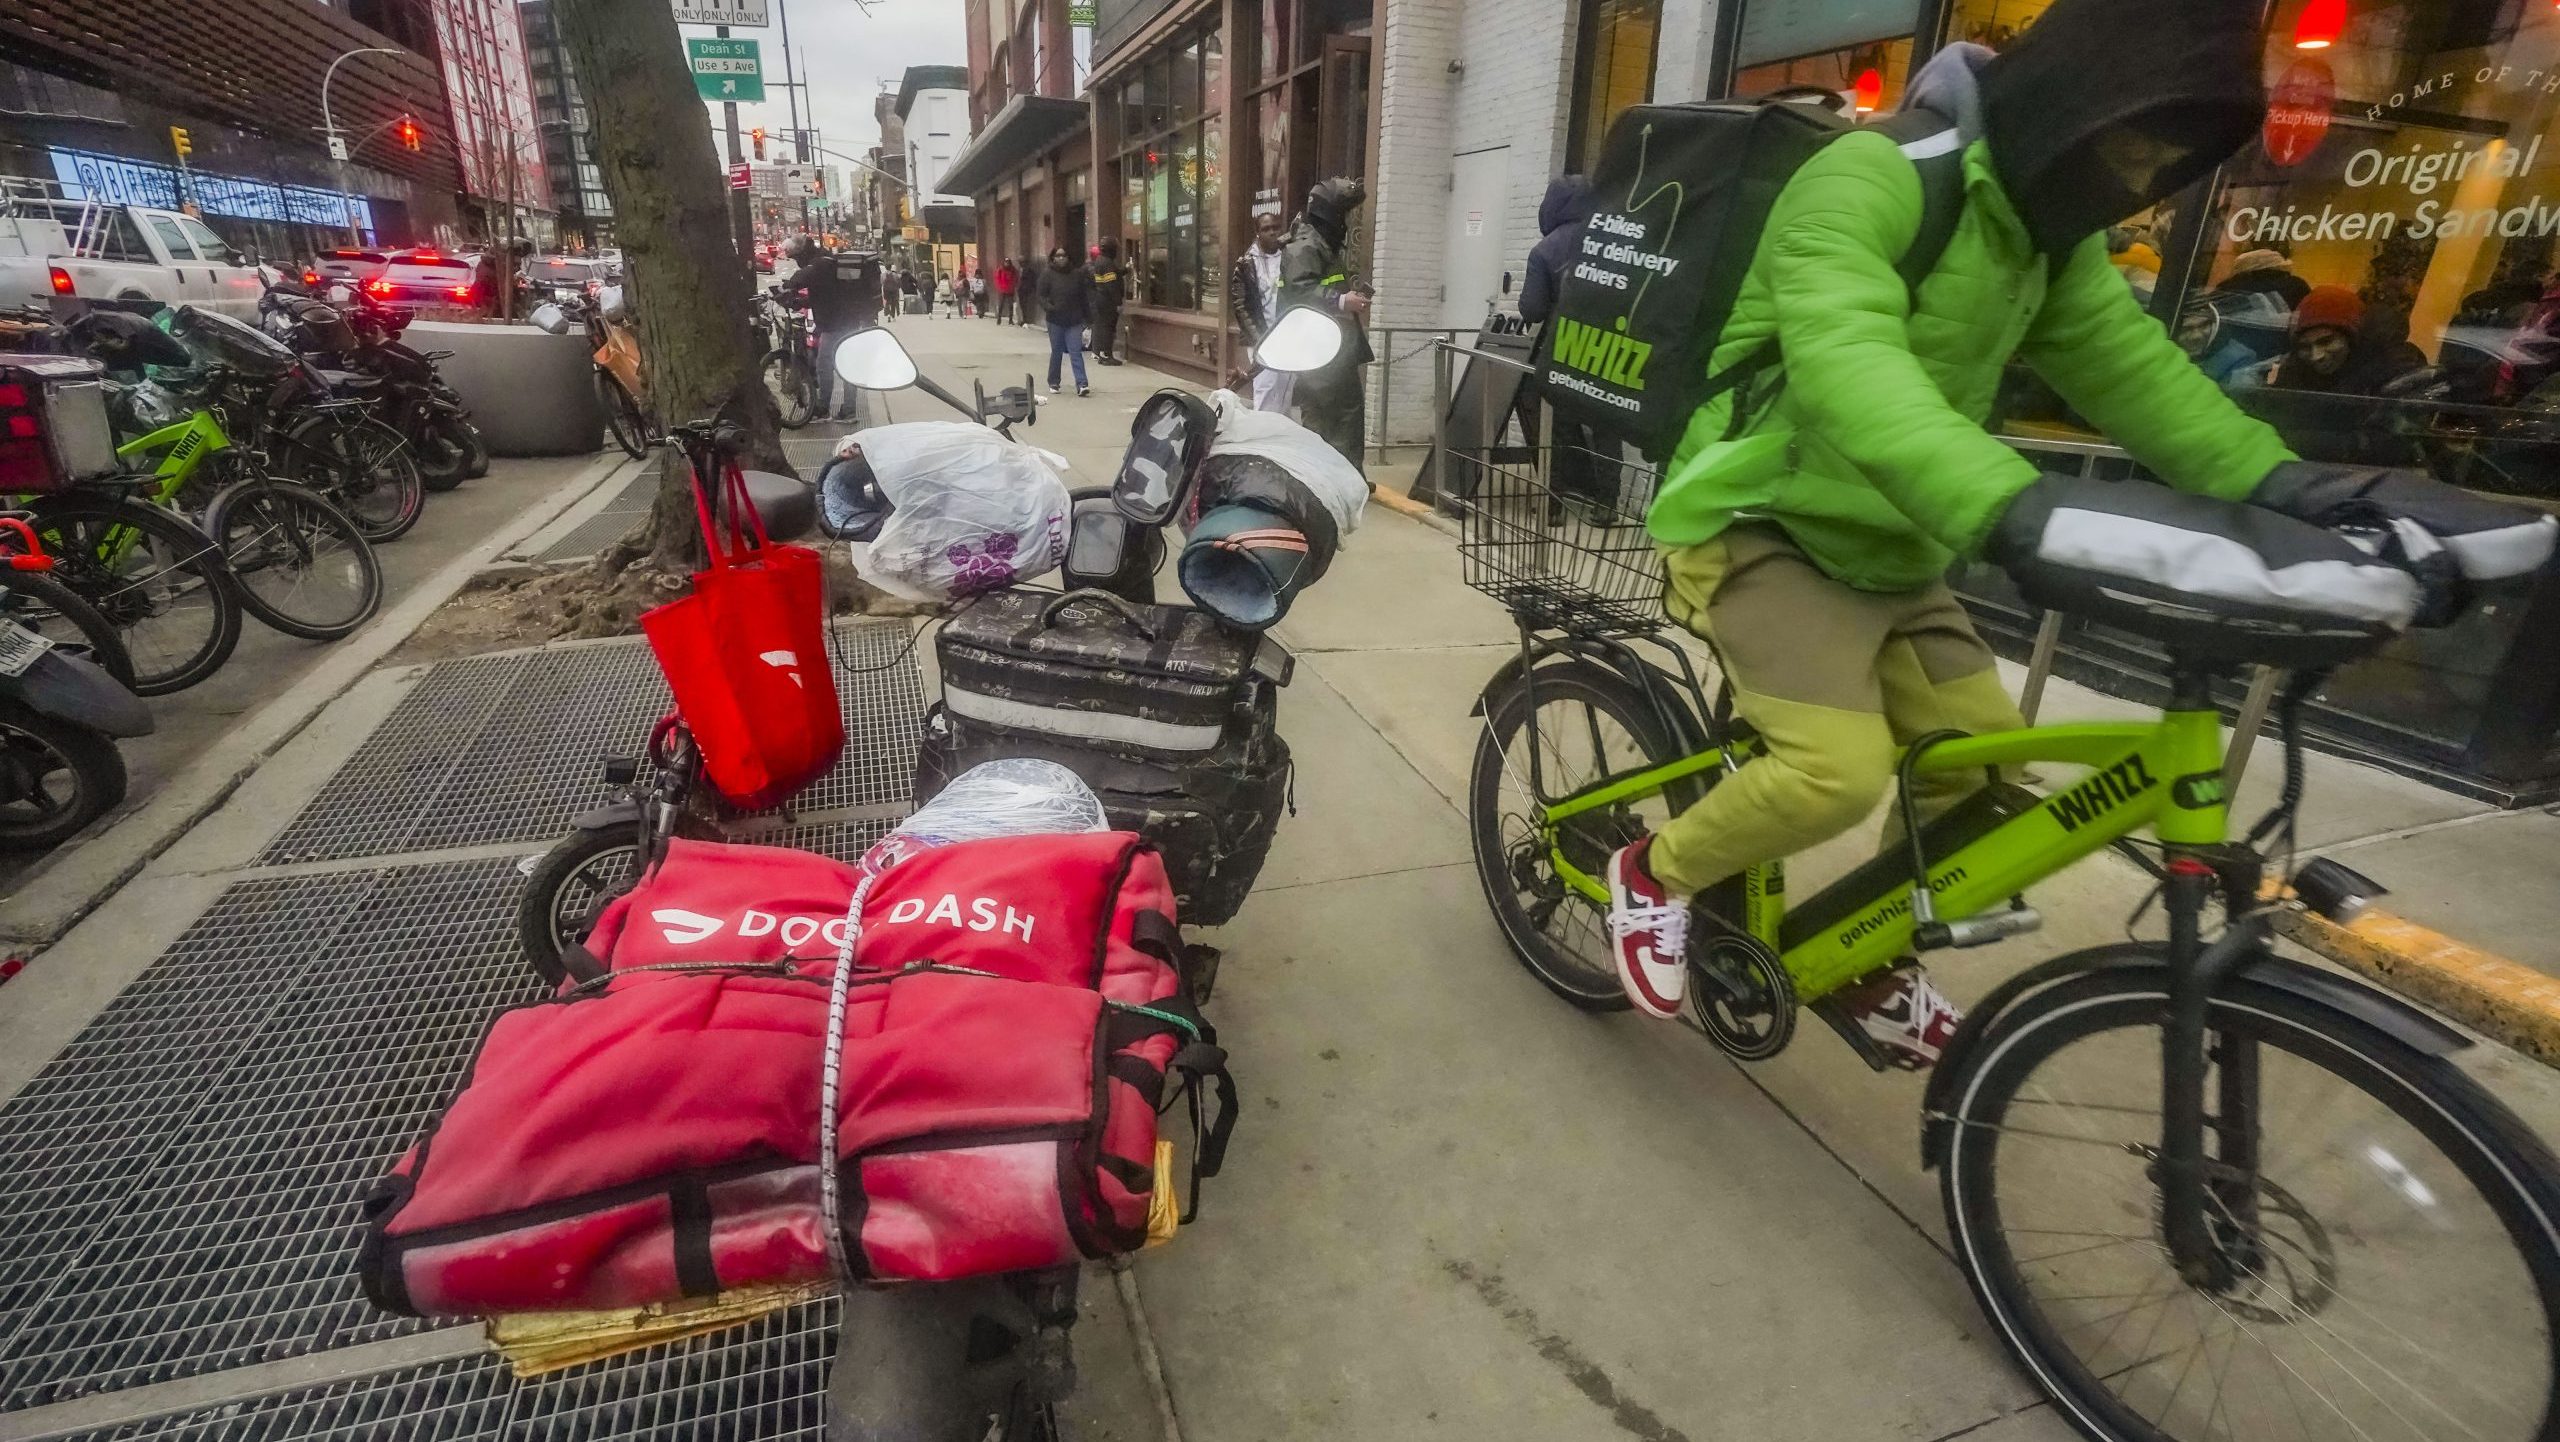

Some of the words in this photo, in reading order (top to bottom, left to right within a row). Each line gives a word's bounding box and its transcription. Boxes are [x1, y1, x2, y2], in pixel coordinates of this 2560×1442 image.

[673, 9, 700, 20] ONLY
[704, 10, 731, 20] ONLY
[736, 11, 763, 22] ONLY
[697, 61, 718, 71] Use
[722, 61, 729, 71] 5
[735, 61, 755, 72] Ave
[701, 43, 730, 55] Dean
[735, 44, 746, 55] St
[2366, 72, 2454, 122] HOME
[2475, 66, 2512, 83] OF
[2303, 111, 2330, 127] Here
[2344, 133, 2543, 195] Original
[1587, 212, 1646, 239] E-bikes
[2227, 203, 2396, 242] Chicken
[1582, 235, 1604, 256] for
[1603, 242, 1680, 277] delivery
[1574, 261, 1629, 290] drivers
[1548, 370, 1640, 412] getwhizz.com
[171, 429, 204, 461] WHIZZ
[2047, 752, 2158, 834] WHIZZ
[1840, 867, 1968, 949] getwhizom
